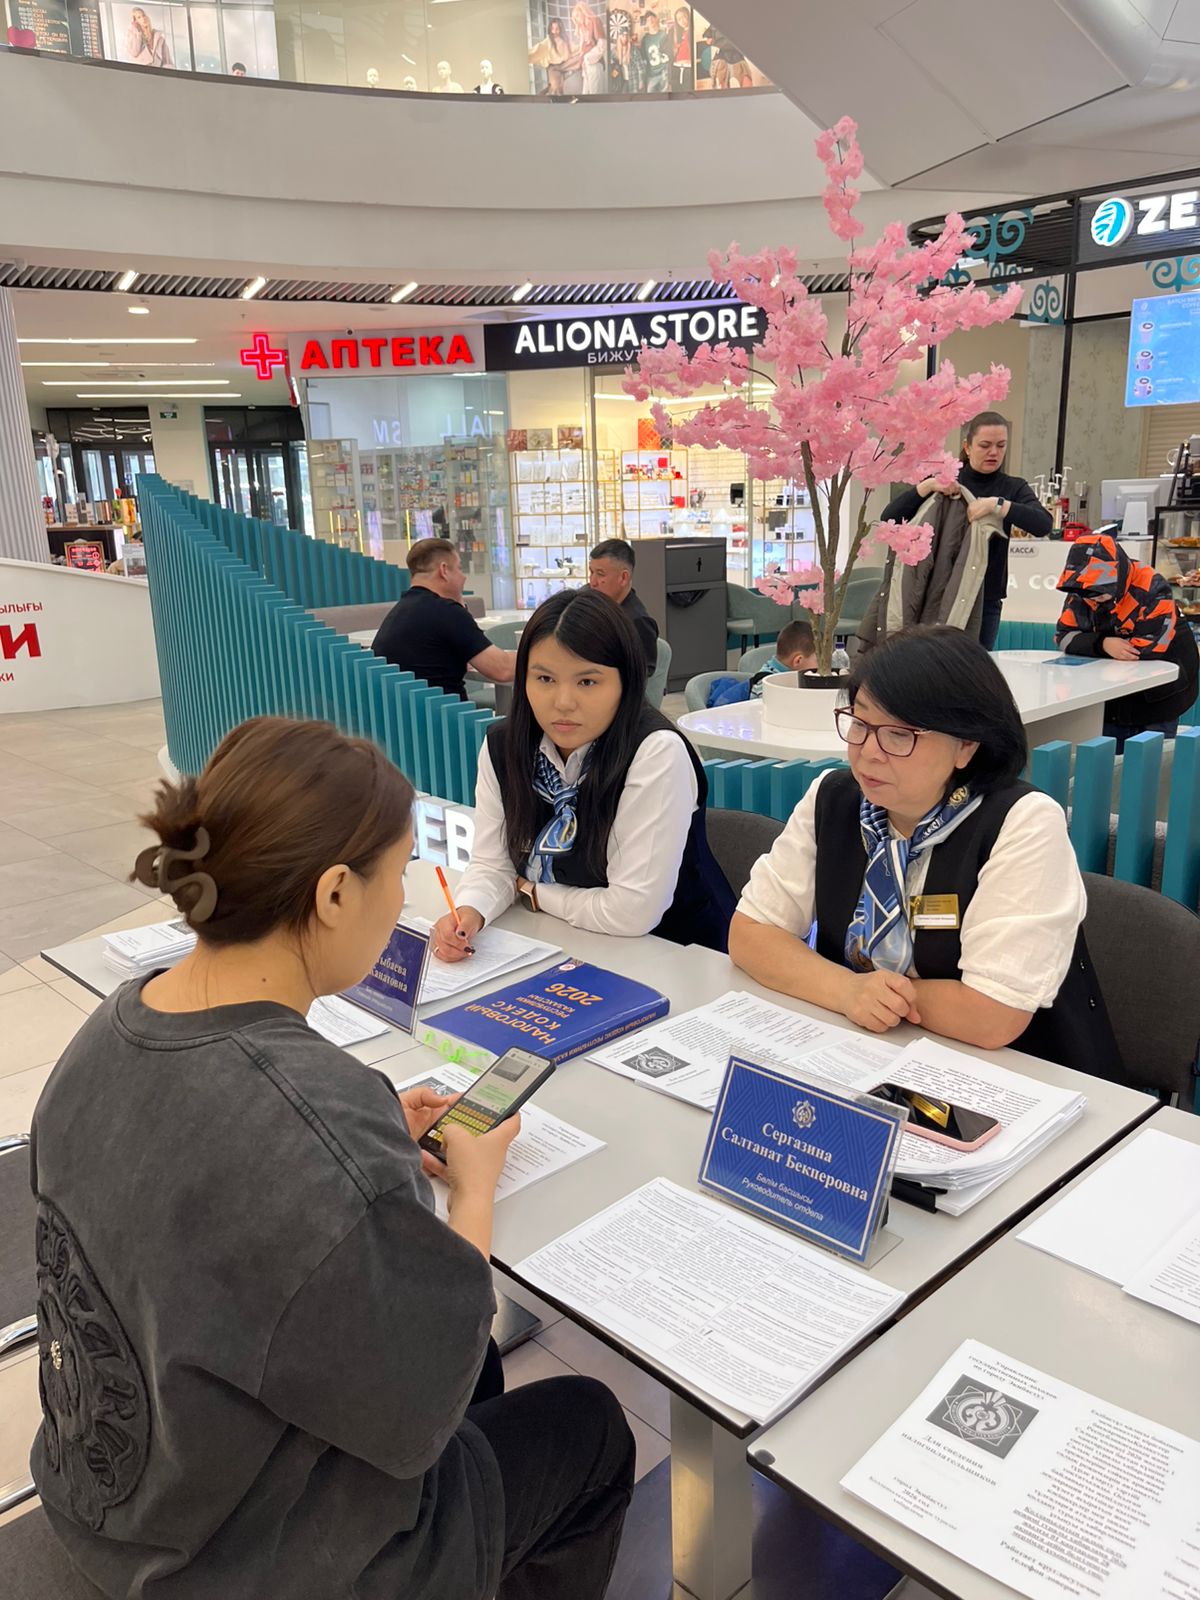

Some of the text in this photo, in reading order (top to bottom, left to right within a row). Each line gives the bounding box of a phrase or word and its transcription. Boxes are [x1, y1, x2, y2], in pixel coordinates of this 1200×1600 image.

[1137, 190, 1199, 235] ZE
[301, 335, 475, 369] АПТЕКА
[1009, 546, 1035, 554] КАССА
[1028, 574, 1057, 590] CO
[0, 623, 42, 660] И
[414, 800, 476, 873] EB
[379, 956, 408, 977] ыбаева
[544, 983, 604, 1006] 2026
[464, 1003, 556, 1044] НАЛОГОВЫЙ
[491, 1000, 561, 1030] КОДЕКС
[762, 1122, 833, 1163] Сергазина
[721, 1126, 869, 1202] Салтанат Бекперовна
[741, 1176, 825, 1221] Руководитель отдела
[778, 1182, 814, 1205] басшысы
